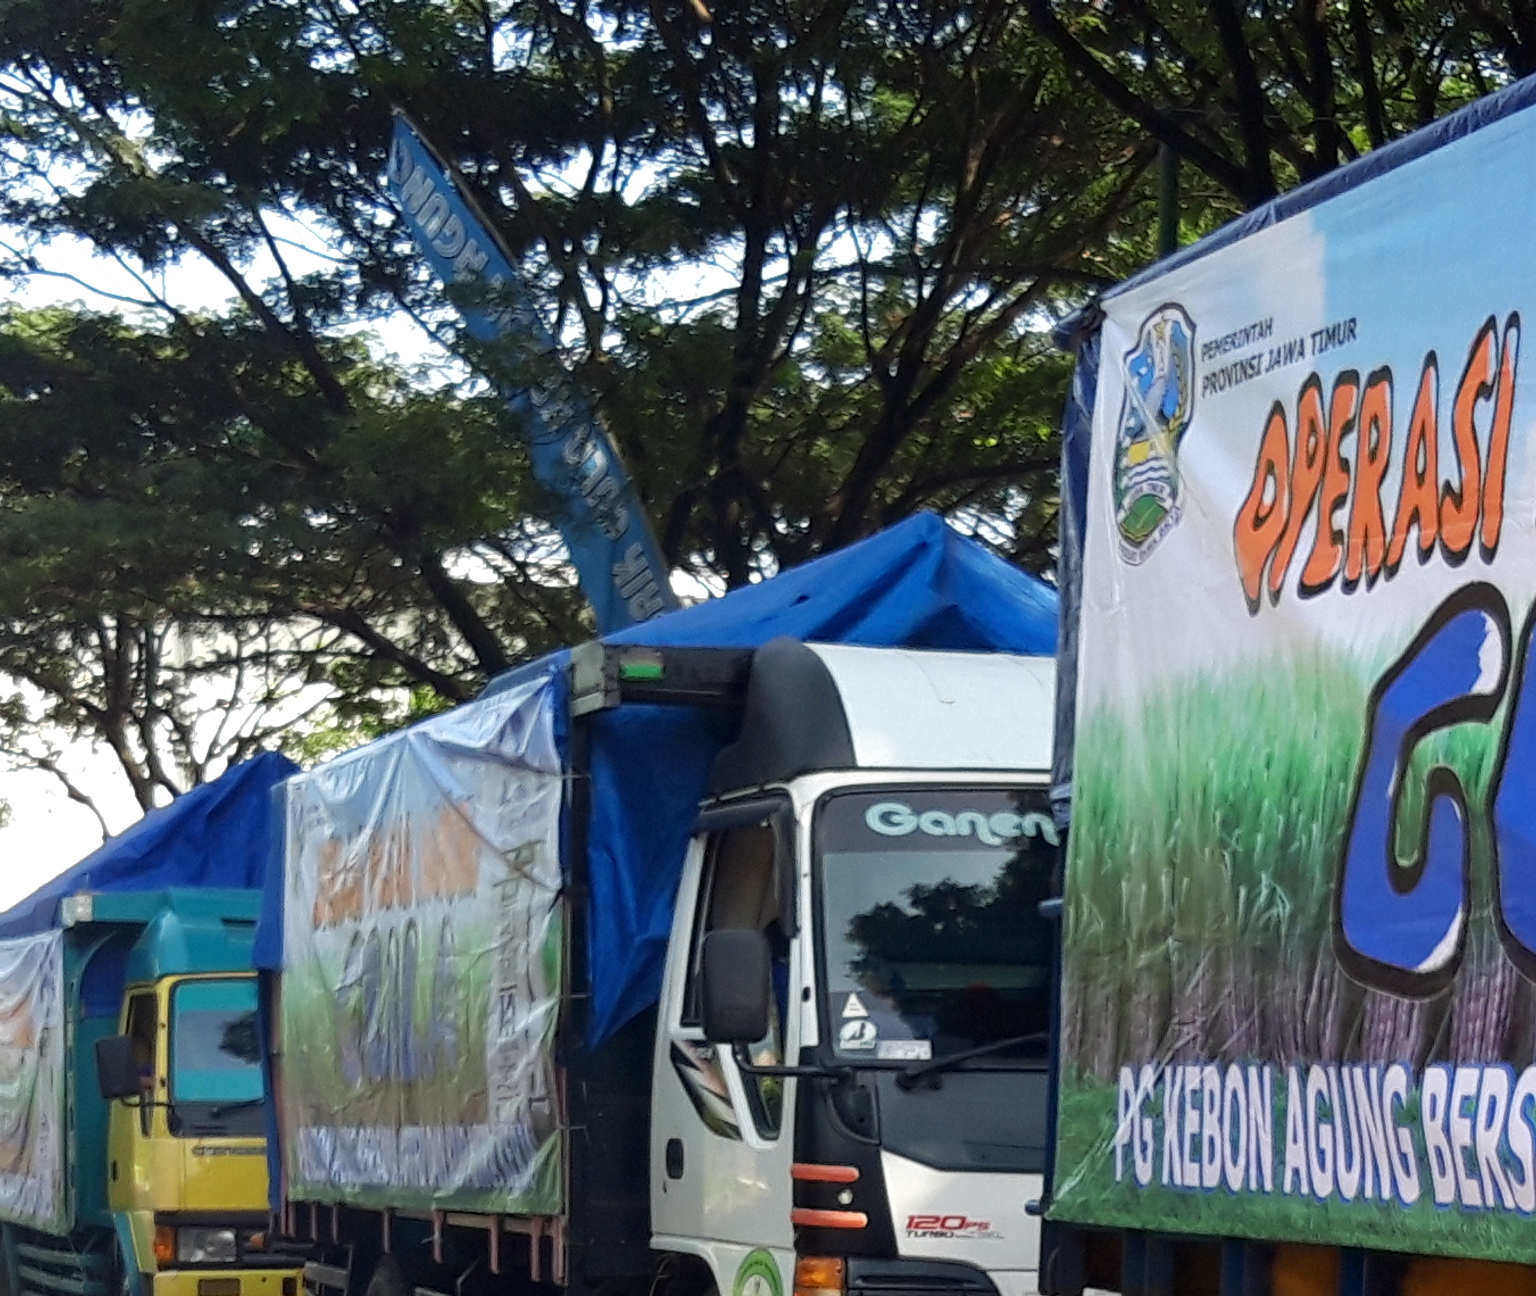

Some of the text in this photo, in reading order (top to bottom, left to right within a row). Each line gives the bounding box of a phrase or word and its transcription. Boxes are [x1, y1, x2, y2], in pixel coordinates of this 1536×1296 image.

[1201, 317, 1274, 362] PEMERINTAH
[1202, 317, 1358, 398] PROVINSI JAWA TIMUR
[1233, 311, 1521, 616] OPERASI
[1114, 1064, 1156, 1187] PG
[1161, 1063, 1273, 1194] KEBON
[1283, 1063, 1422, 1205] AGUNG
